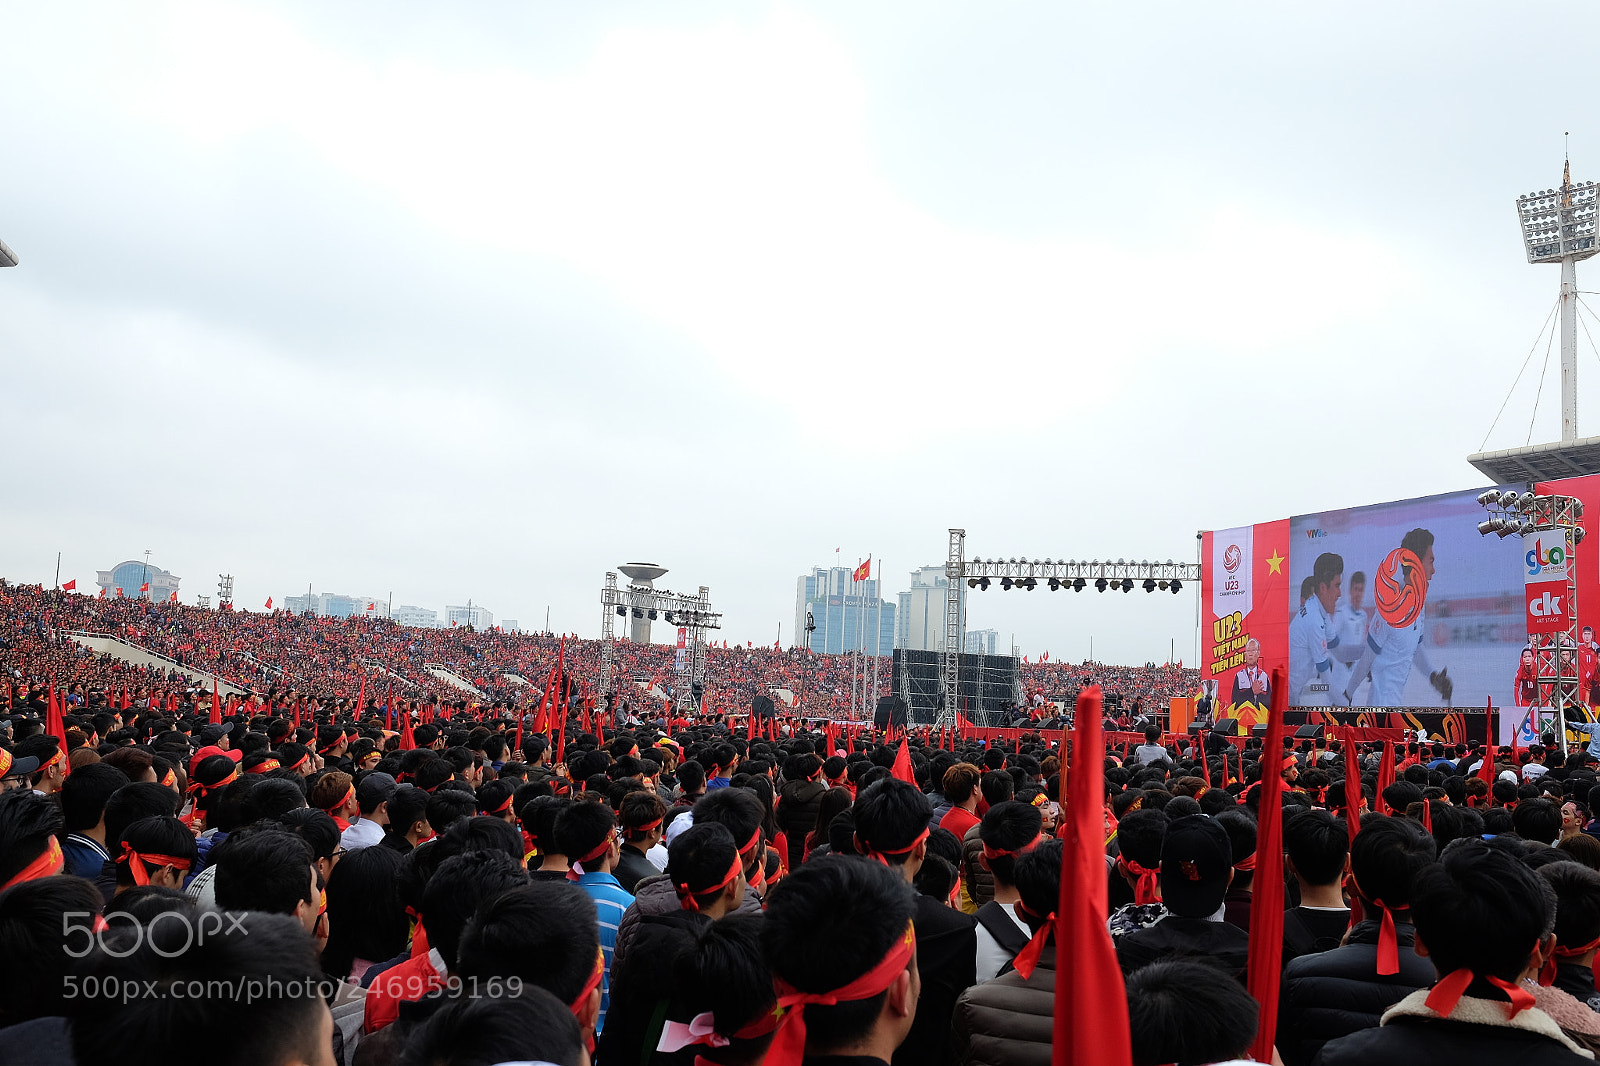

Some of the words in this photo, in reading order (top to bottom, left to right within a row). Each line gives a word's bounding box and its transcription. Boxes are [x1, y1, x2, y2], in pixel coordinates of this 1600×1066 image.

[1224, 580, 1239, 591] U23
[1213, 610, 1242, 643] U23
[1231, 633, 1250, 652] NAM
